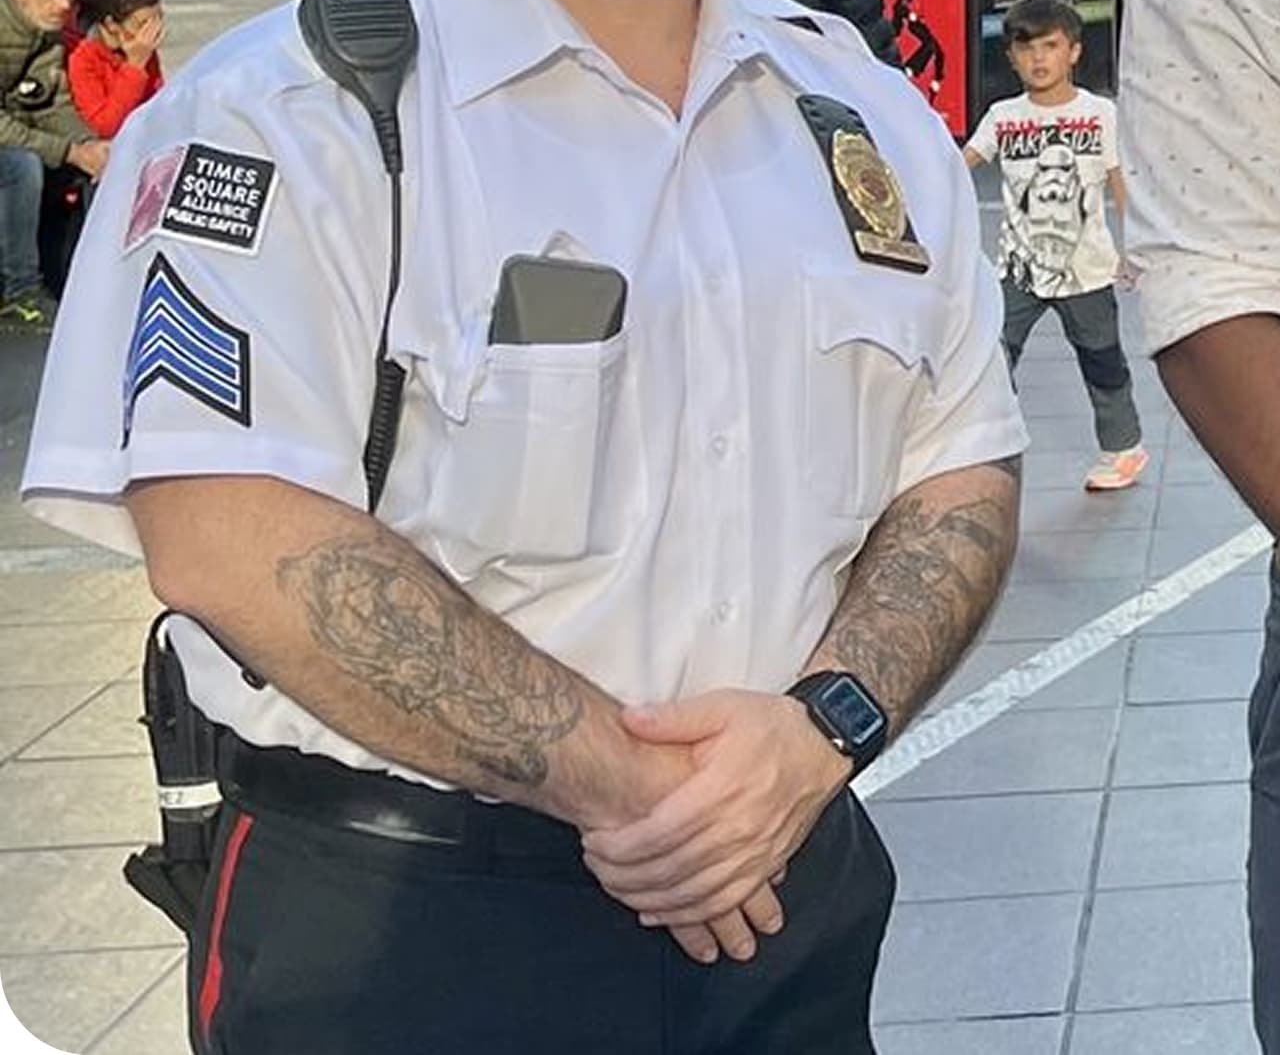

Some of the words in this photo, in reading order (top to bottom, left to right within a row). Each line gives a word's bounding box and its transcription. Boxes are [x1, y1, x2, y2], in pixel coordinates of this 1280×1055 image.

[1001, 128, 1055, 158] DARK
[1060, 128, 1102, 152] SIDE
[196, 157, 258, 185] TIMES
[182, 174, 261, 207] SQUARE
[181, 194, 251, 221] ALLIANCE
[167, 207, 207, 228] PUBLIC
[208, 217, 254, 239] SAFETY
